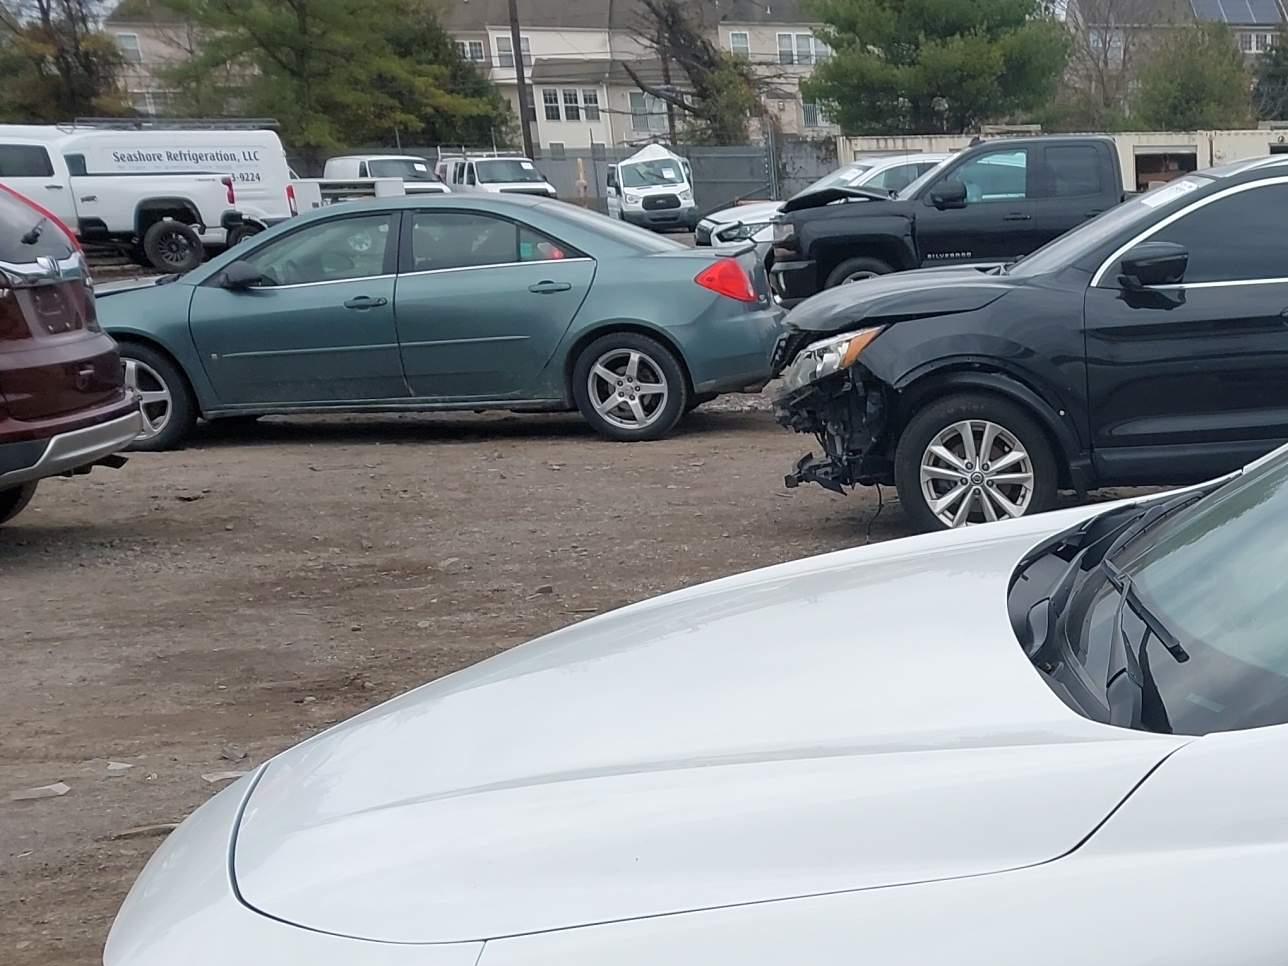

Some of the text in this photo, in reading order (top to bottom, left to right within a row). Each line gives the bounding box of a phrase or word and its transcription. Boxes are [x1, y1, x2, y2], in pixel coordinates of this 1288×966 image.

[112, 150, 260, 164] Seashore Refrigeration, LLC
